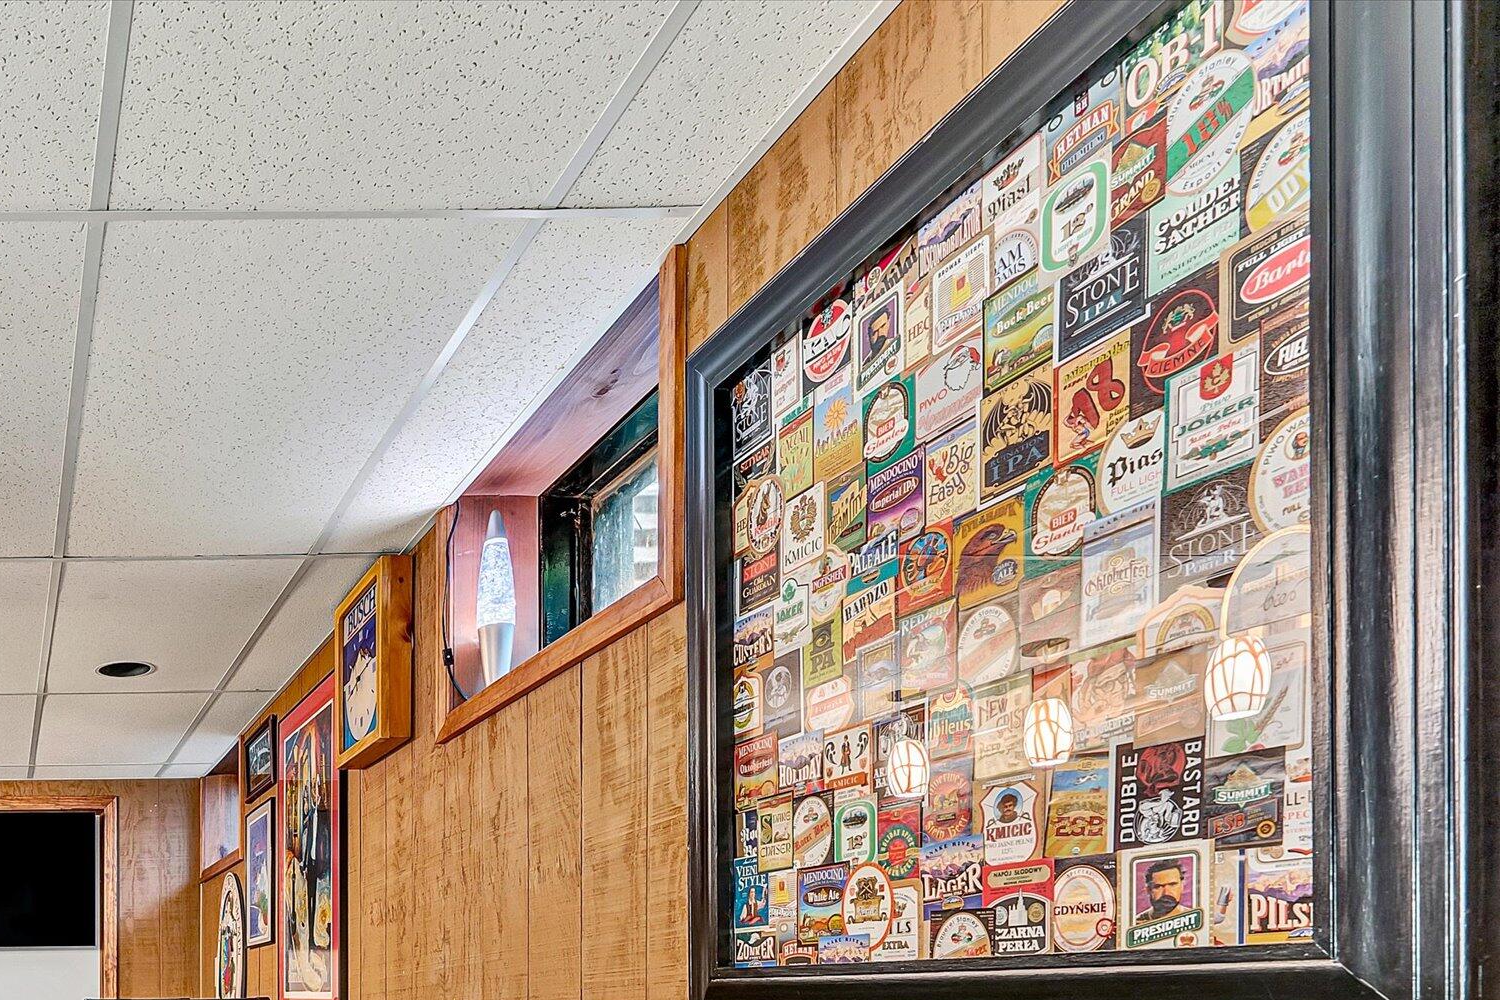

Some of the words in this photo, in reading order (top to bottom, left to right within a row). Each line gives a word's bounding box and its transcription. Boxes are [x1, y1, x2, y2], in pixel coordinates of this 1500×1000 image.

[1056, 109, 1109, 159] HETMAN
[1238, 250, 1266, 272] FULL
[1270, 227, 1304, 254] LIGHT
[938, 257, 960, 279] BROWAR
[1065, 256, 1139, 328] STONE
[1084, 292, 1117, 322] IPA
[996, 307, 1022, 334] Bock
[1026, 288, 1052, 315] Beer
[861, 338, 897, 381] PRESIDENT
[1150, 336, 1206, 374] CIEMNE
[919, 387, 947, 413] PIWO
[1072, 354, 1125, 435] 18
[877, 418, 893, 436] BIER
[1176, 392, 1254, 440] JOKER
[946, 435, 975, 475] Big
[992, 442, 1045, 482] IPA
[1107, 438, 1162, 487] Pias
[870, 452, 917, 492] MENDOCINO
[1110, 479, 1133, 497] FULL
[1139, 466, 1161, 484] LIGH
[872, 485, 901, 511] Imperial
[903, 477, 915, 493] IPA
[929, 467, 967, 508] Easy
[1052, 510, 1074, 528] BIER
[785, 534, 821, 567] KMICIC
[848, 544, 872, 577] PALE
[872, 531, 895, 565] ALE
[1167, 516, 1256, 578] STONE
[1184, 547, 1236, 577] PORTER
[744, 552, 775, 580] STONE
[753, 574, 763, 586] Old
[742, 572, 776, 599] GUARDIAN
[845, 580, 887, 621] BARDZO
[348, 586, 376, 635] BUSCH
[733, 628, 771, 666] CUSTER'S
[1148, 678, 1195, 699] SUMMIT
[979, 696, 1007, 726] NEW
[738, 736, 772, 757] MENDOCINO
[740, 755, 772, 774] Oktoberfest
[779, 754, 821, 787] HOLIDAY
[833, 775, 858, 789] KMICIC
[1181, 740, 1201, 837] BASTARD
[1216, 782, 1269, 803] SUMMIT
[1119, 752, 1138, 844] DOUBLE
[986, 821, 1031, 841] KMICIC
[1212, 812, 1244, 834] ESB
[738, 873, 764, 891] STYLE
[803, 867, 843, 883] MENDOCINO
[922, 864, 981, 901] LAGER
[993, 869, 1011, 879] NAPÓJ
[1014, 865, 1042, 875] SŁODOWY
[807, 890, 826, 902] White
[828, 888, 839, 900] Ale
[1053, 898, 1105, 916] GDYŃSKIE
[1249, 888, 1312, 932] PILS
[1133, 912, 1196, 941] PRESIDENT
[737, 935, 774, 961] ZONKER
[882, 939, 908, 950] EXTRA
[998, 939, 1039, 952] PERŁA
